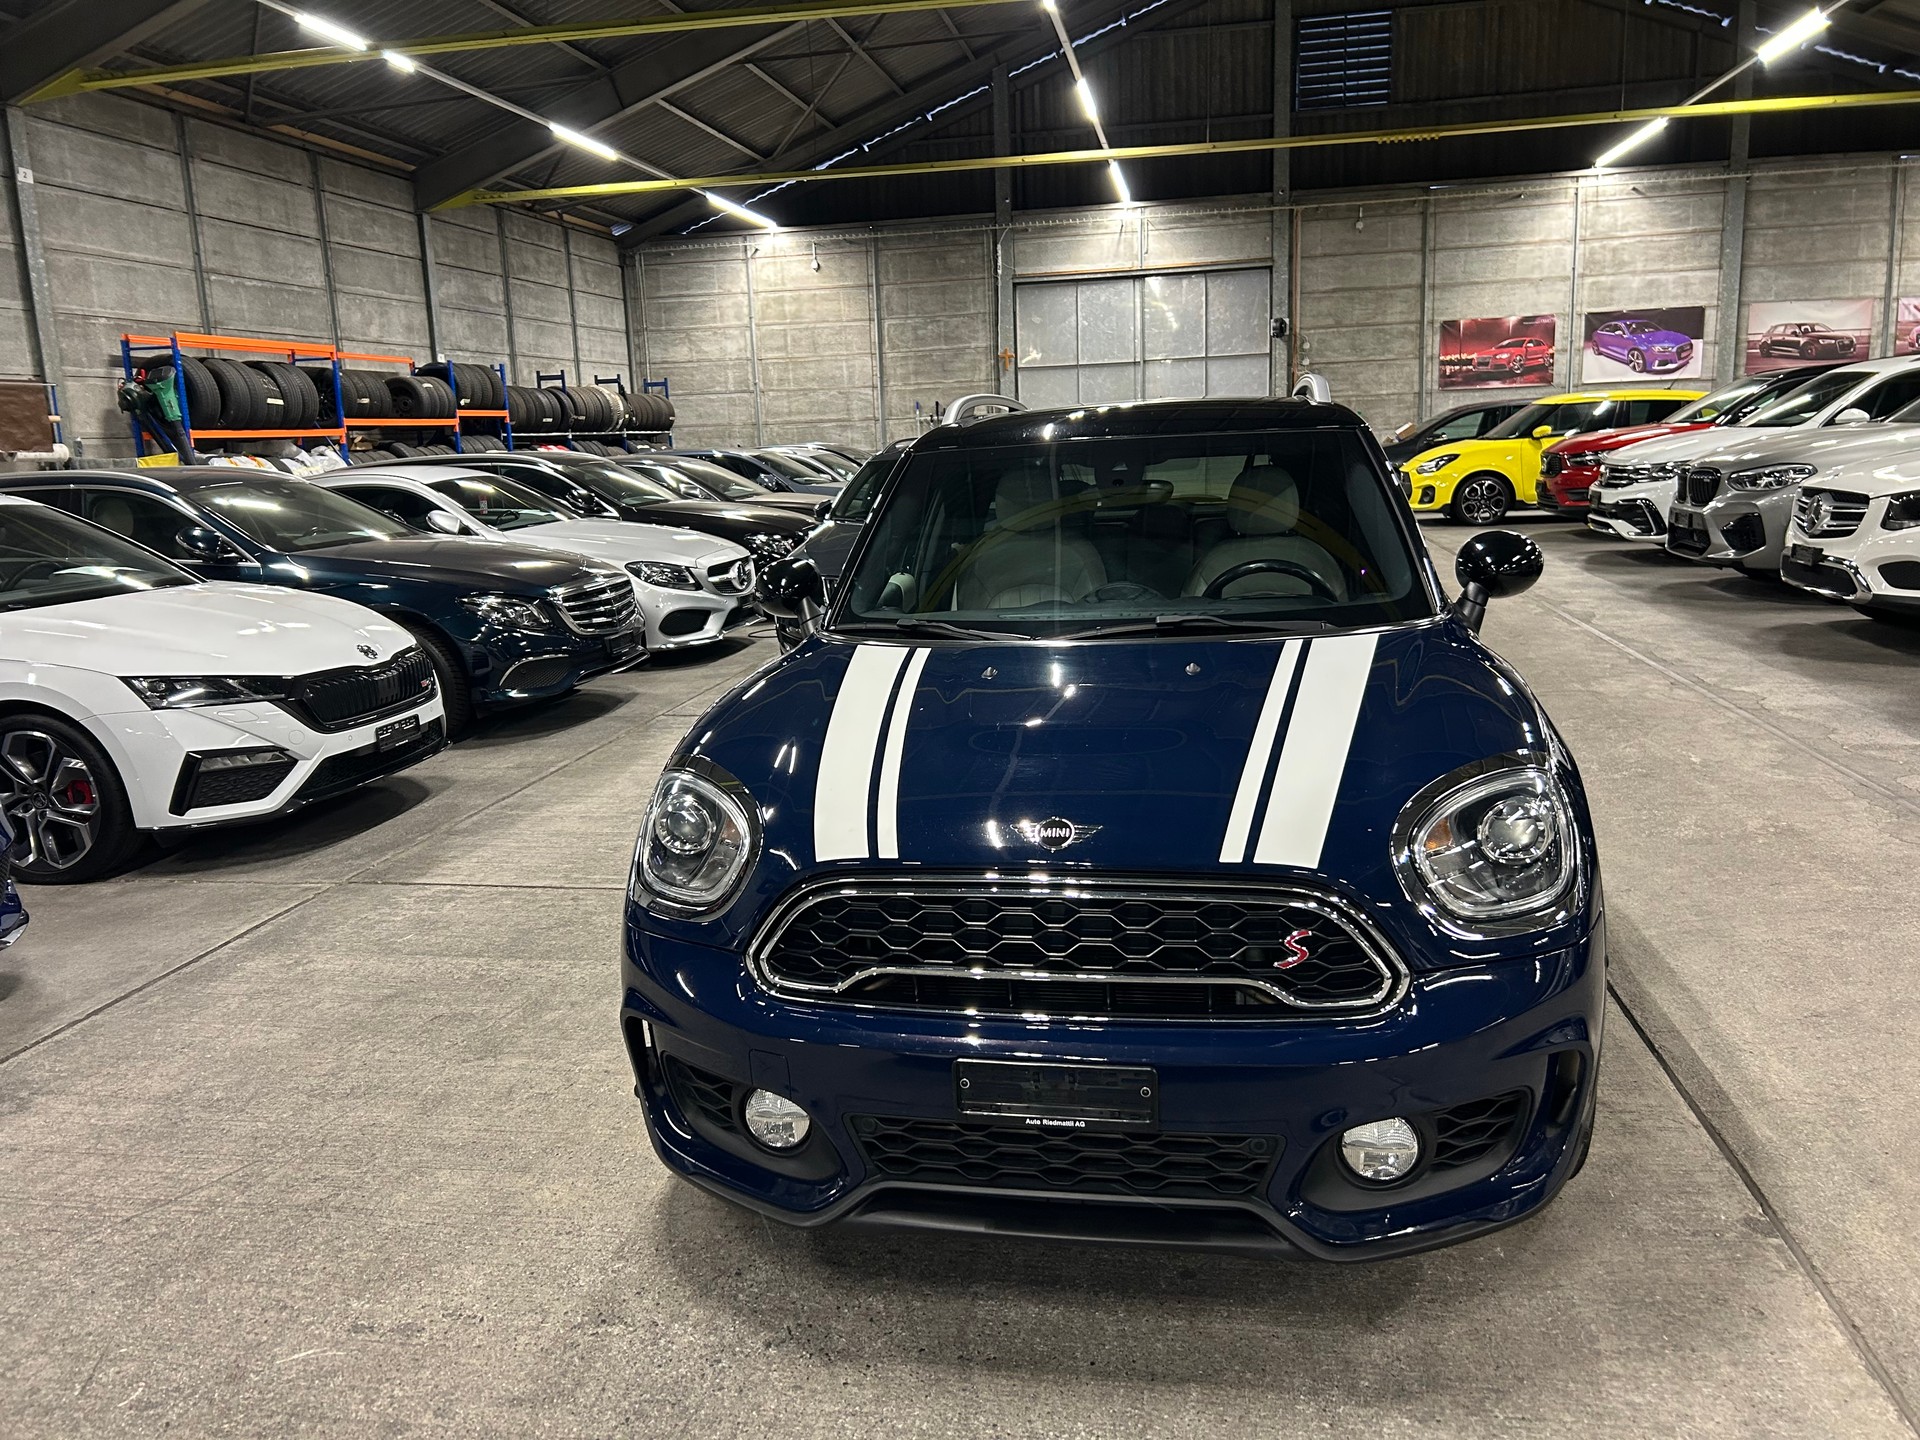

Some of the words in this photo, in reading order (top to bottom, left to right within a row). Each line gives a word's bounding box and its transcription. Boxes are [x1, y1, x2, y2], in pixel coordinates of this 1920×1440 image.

[1040, 827, 1071, 838] MINI
[1272, 929, 1313, 970] S
[1075, 1120, 1086, 1128] AG
